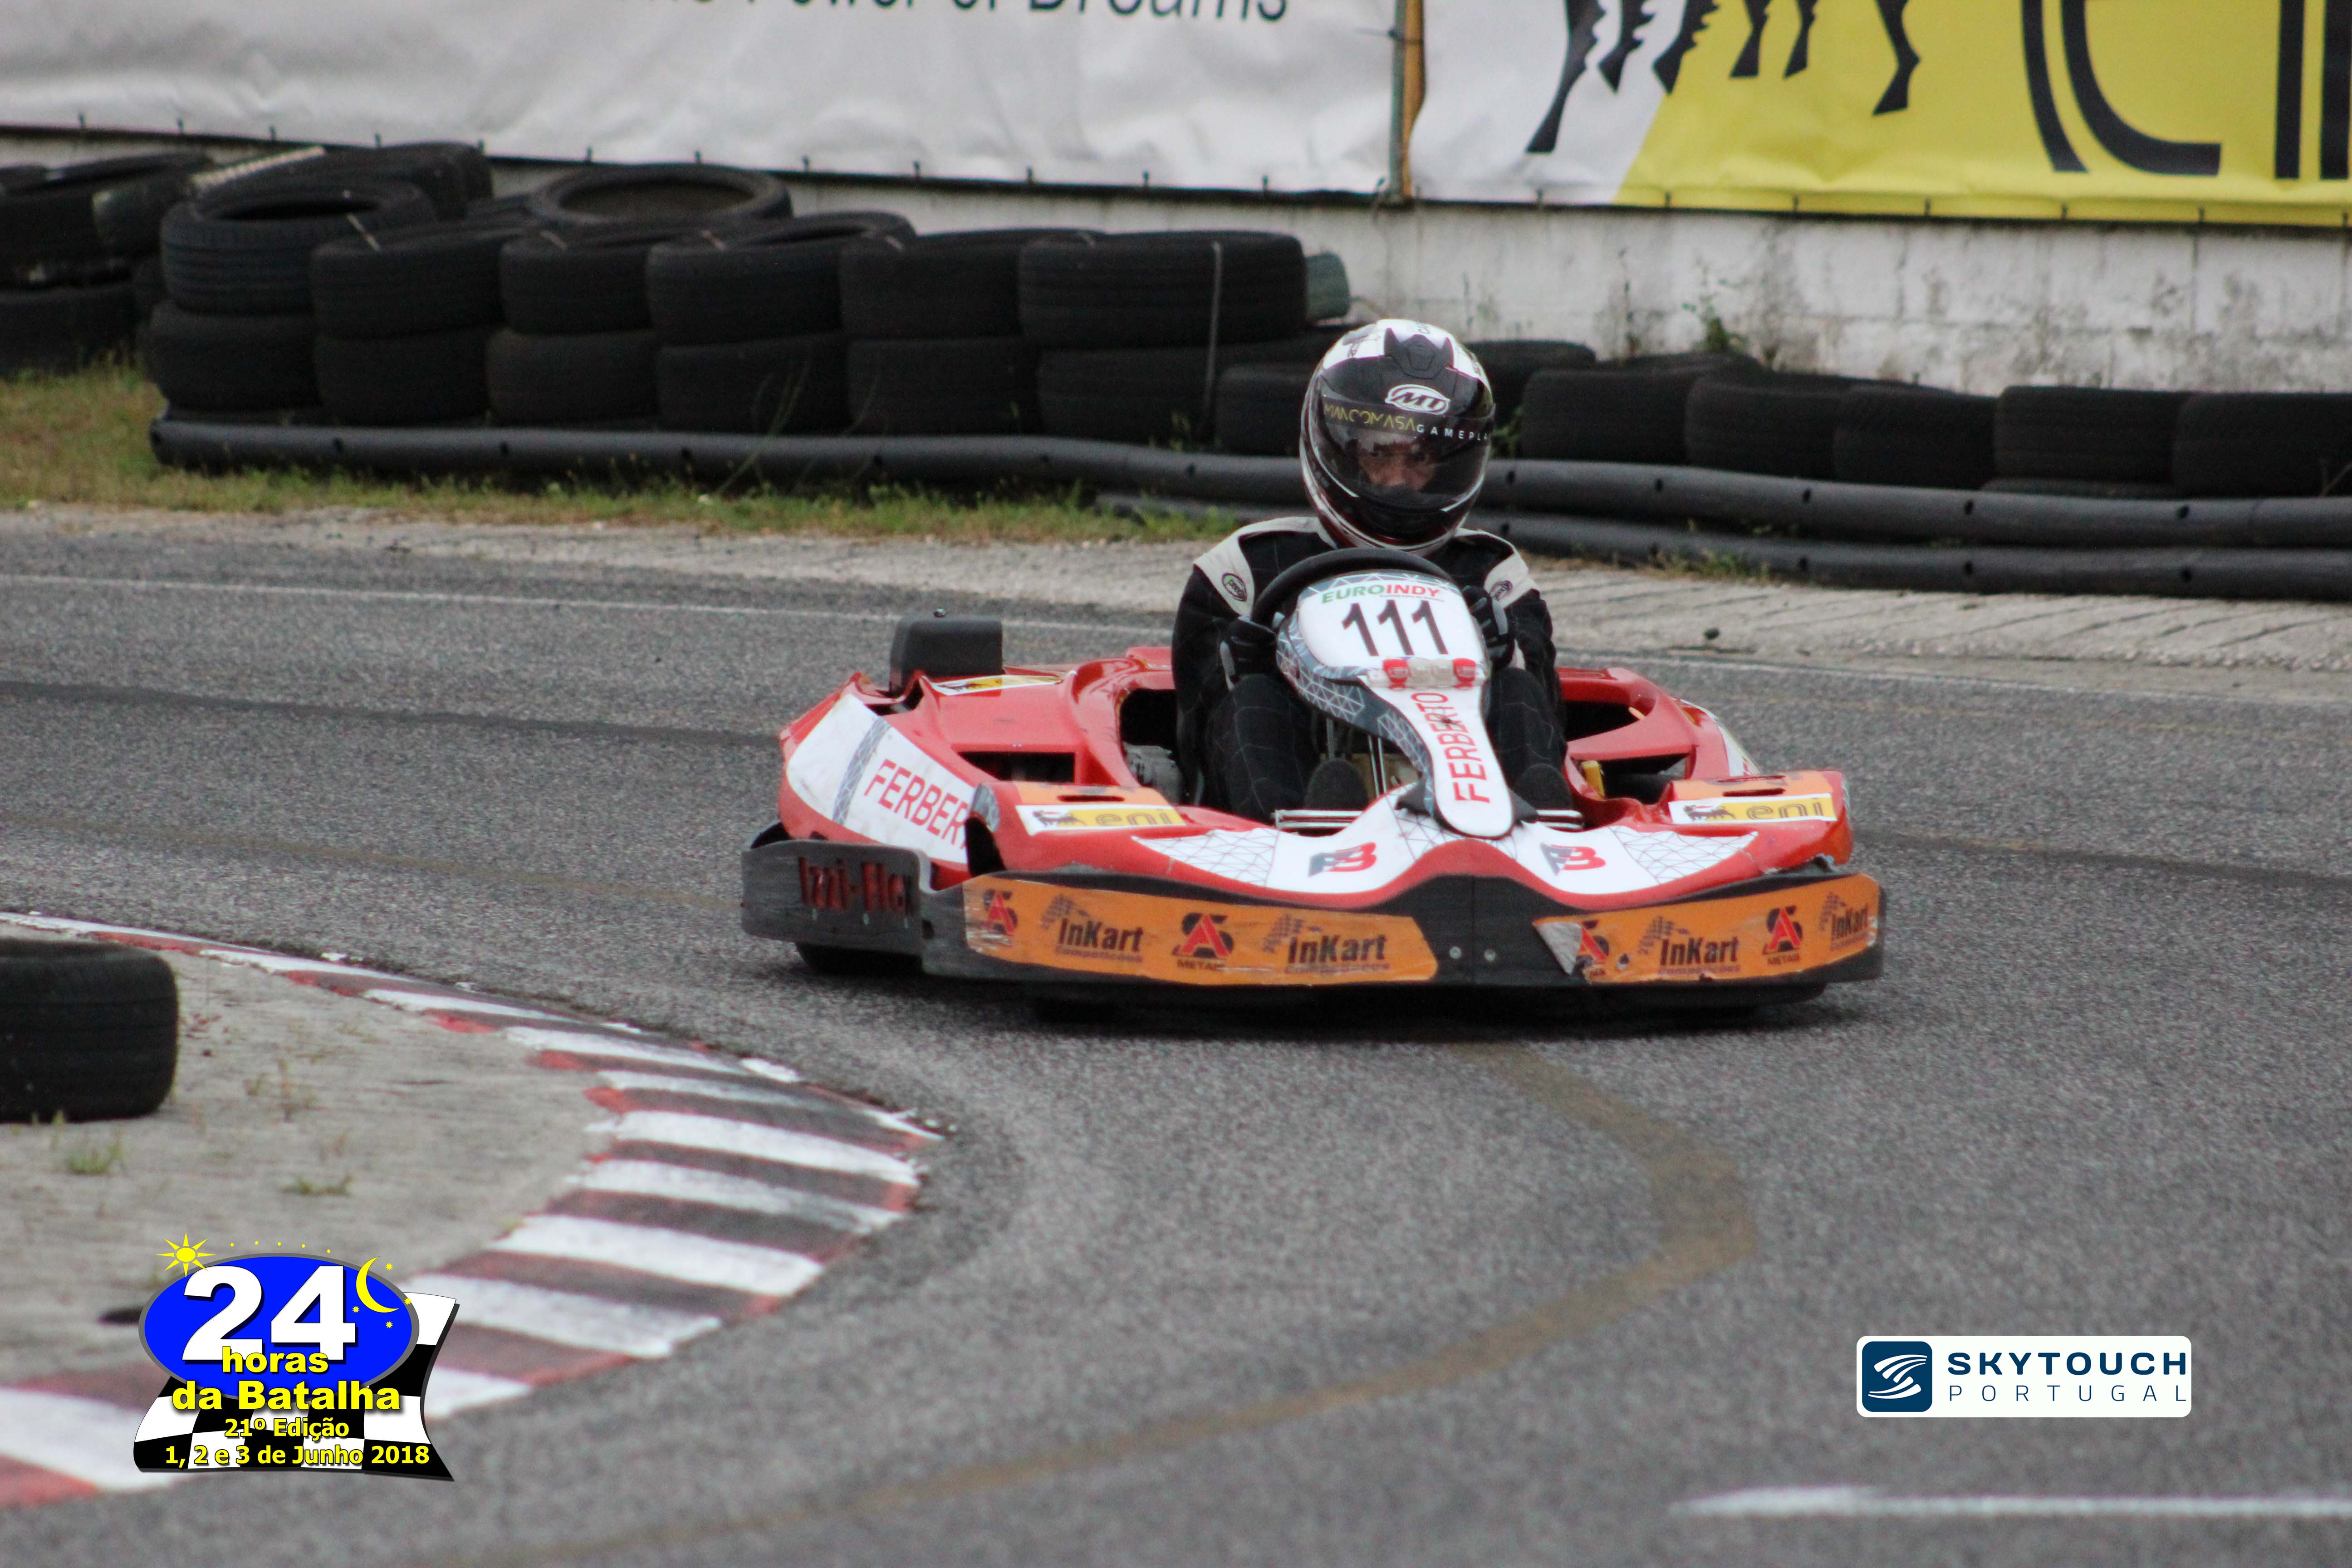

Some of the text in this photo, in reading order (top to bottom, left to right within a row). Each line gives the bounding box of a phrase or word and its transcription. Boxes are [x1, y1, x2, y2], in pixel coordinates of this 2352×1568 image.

[1321, 584, 1441, 604] EUROINDY
[1341, 599, 1449, 657] 111
[1411, 692, 1490, 804] FERBERTO
[863, 758, 969, 850] FERBER
[1095, 808, 1174, 827] eni
[1746, 797, 1824, 820] eni
[1058, 917, 1144, 952] InKart
[1659, 936, 1740, 966] InKart
